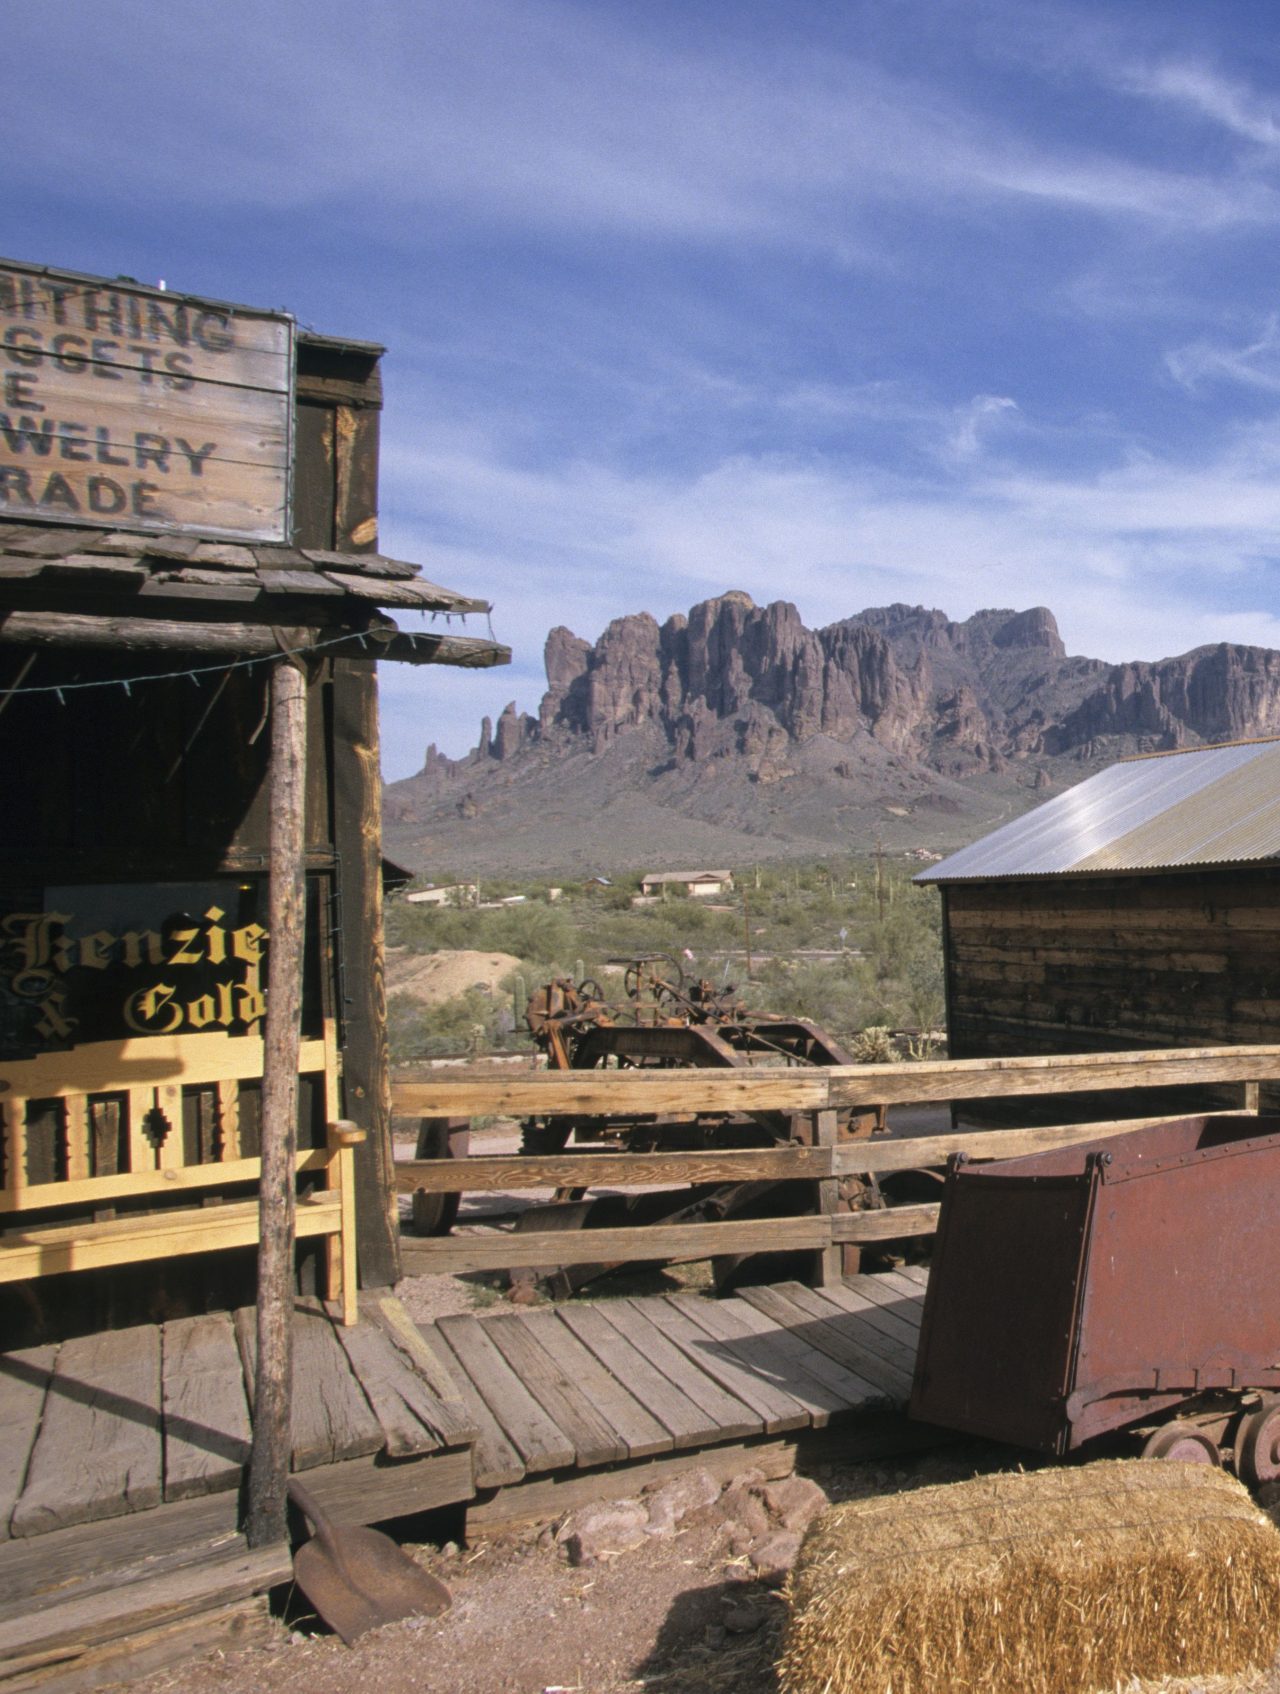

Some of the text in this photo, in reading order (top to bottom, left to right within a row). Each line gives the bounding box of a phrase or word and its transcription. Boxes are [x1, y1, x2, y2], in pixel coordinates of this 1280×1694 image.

[3, 325, 195, 392] GGETS
[0, 412, 217, 477] WELRY
[0, 464, 168, 518] RADE
[123, 979, 268, 1034] Gold
